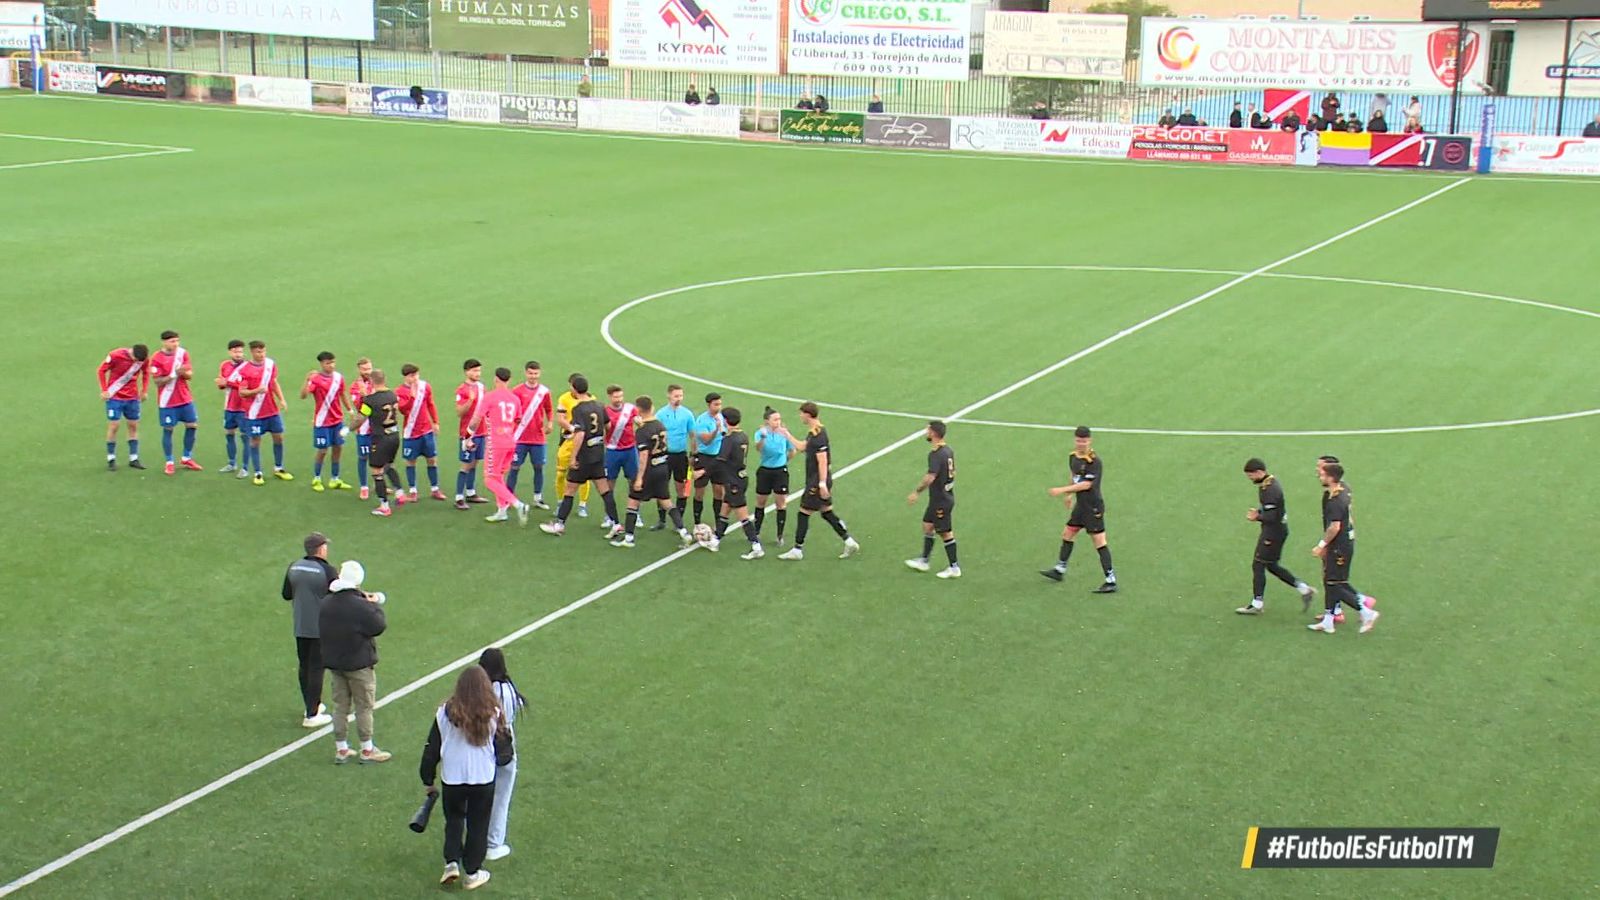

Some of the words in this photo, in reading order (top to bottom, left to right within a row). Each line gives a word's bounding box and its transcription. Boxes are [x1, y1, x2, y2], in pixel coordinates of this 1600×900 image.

[157, 0, 343, 22] INMOBILIARIA
[841, 5, 912, 23] CREGO,
[918, 7, 952, 22] S.L.
[497, 18, 526, 26] SCHOOL
[792, 29, 870, 46] Instalaciones
[873, 33, 887, 46] de
[891, 33, 964, 49] Electricidad
[1228, 27, 1396, 50] MONTAJES
[658, 42, 727, 55] KYRYAK
[804, 50, 849, 60] Libertad,
[853, 52, 864, 60] 33
[873, 52, 915, 63] Torrejón
[917, 54, 929, 63] de
[932, 55, 962, 64] Ardoz
[1210, 51, 1412, 75] COMPLUTUM
[844, 64, 865, 72] 609
[870, 65, 892, 73] 005
[898, 66, 919, 75] 731
[502, 96, 577, 112] PIQUERAS
[1071, 125, 1132, 138] Inmobiliaria
[1133, 127, 1228, 142] PERGONET
[1082, 137, 1120, 149] Edicasa
[498, 400, 515, 422] 13
[589, 412, 598, 434] 3
[361, 446, 370, 454] 11
